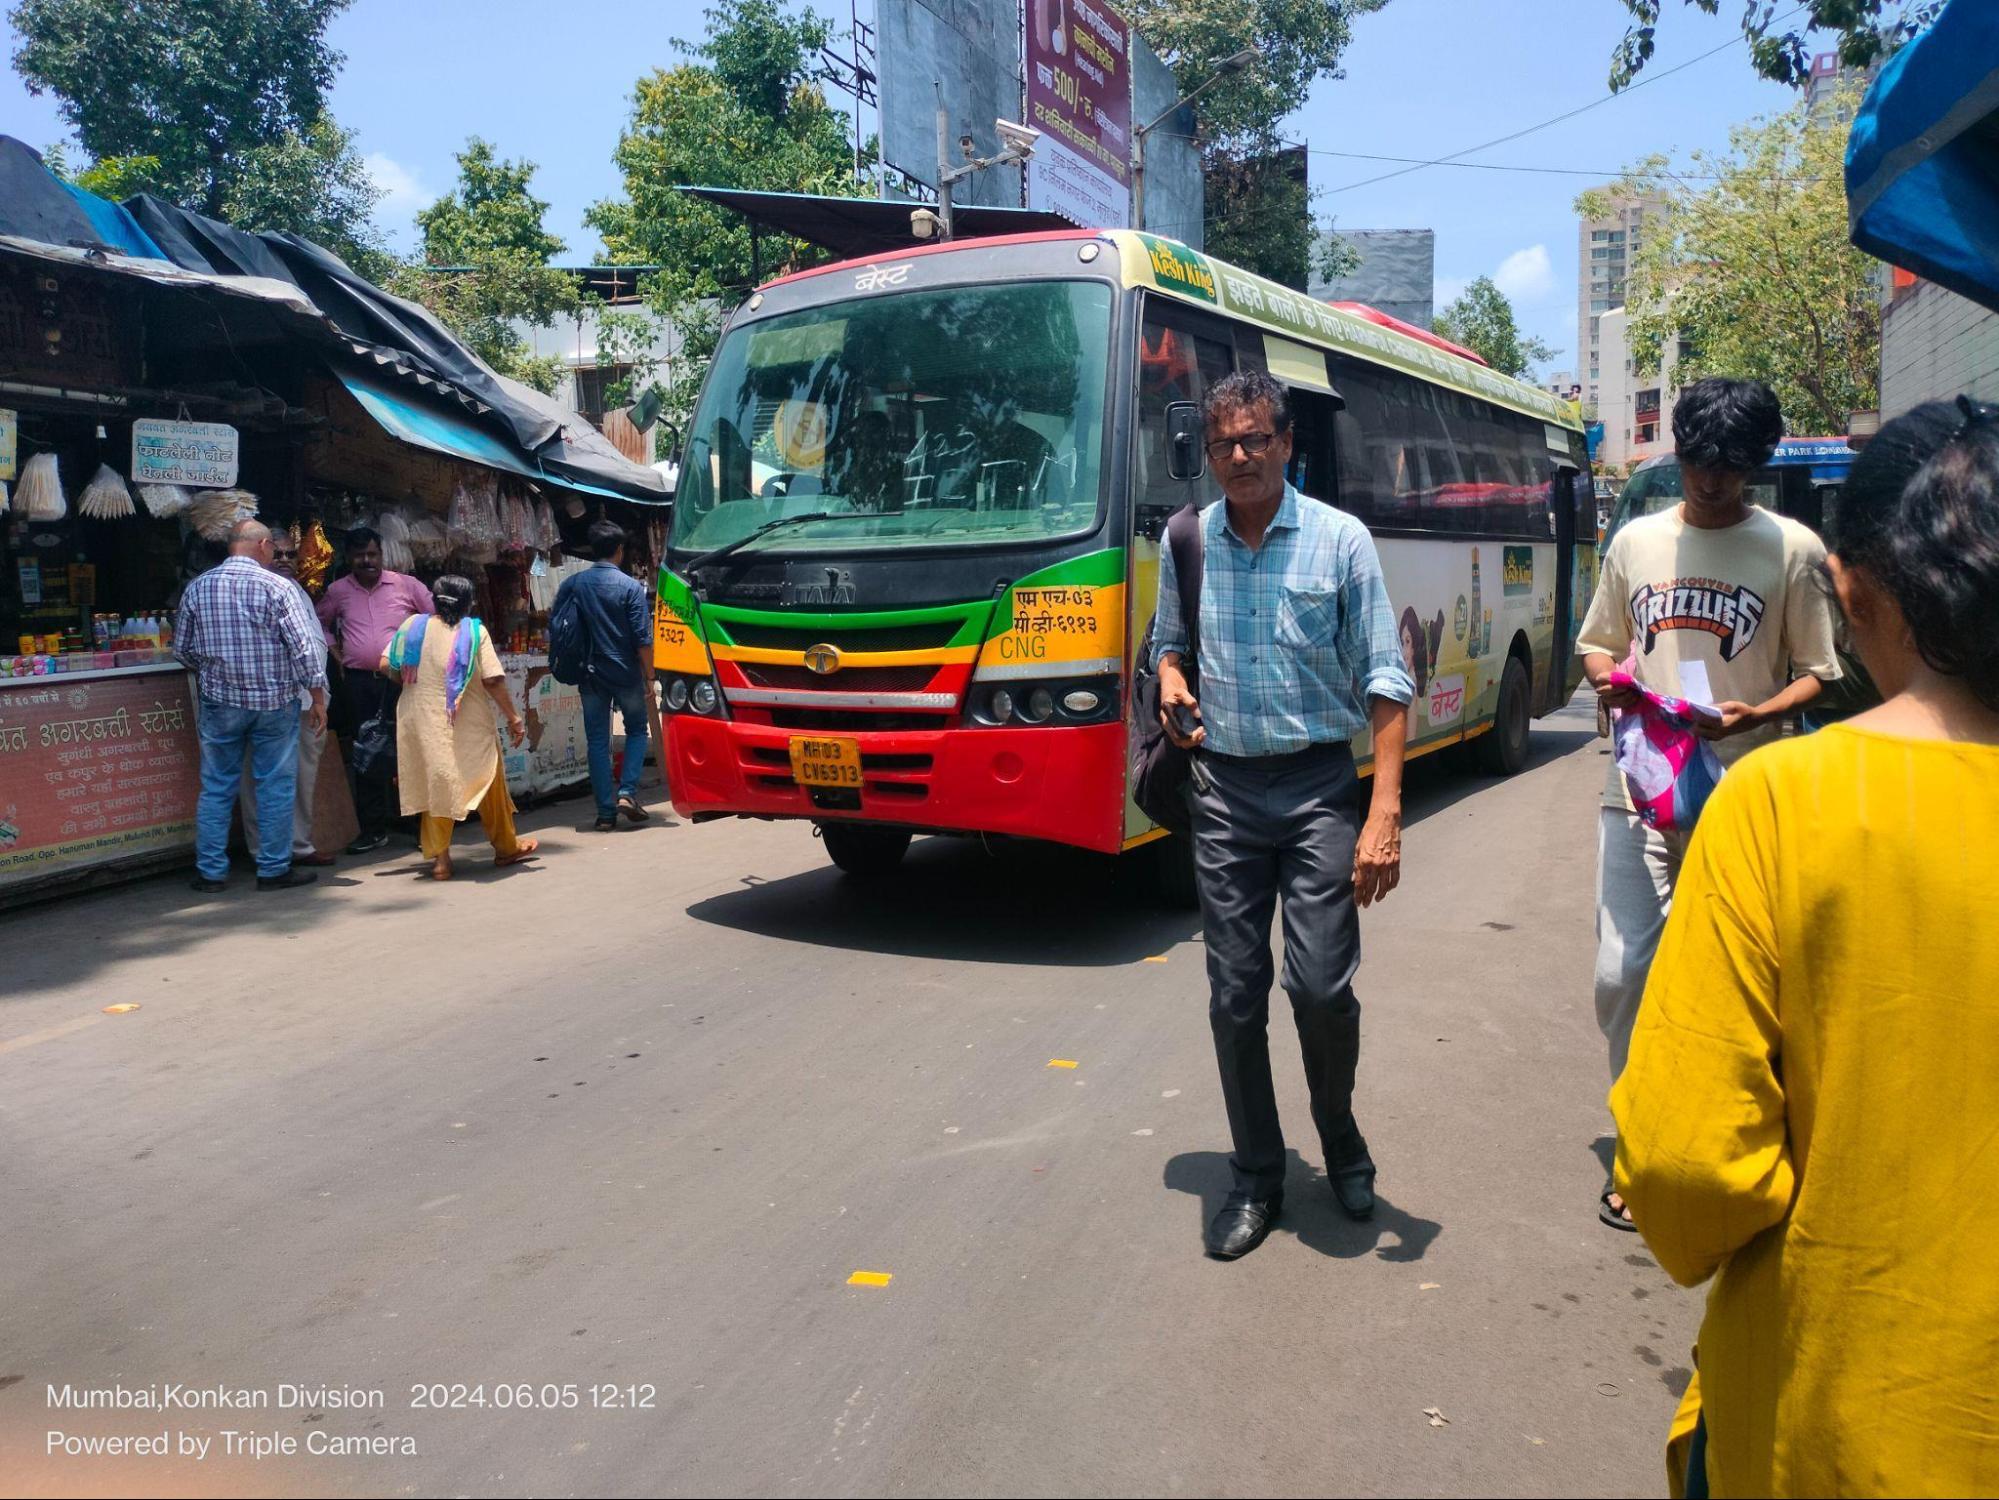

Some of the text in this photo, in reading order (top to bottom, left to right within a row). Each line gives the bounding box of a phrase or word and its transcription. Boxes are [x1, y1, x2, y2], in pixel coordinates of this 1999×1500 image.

[1054, 66, 1084, 113] 500/-
[856, 264, 913, 290] बेस्ट
[1150, 250, 1215, 297] Kesh King
[1299, 298, 1316, 329] के
[1313, 303, 1344, 342] लिए
[203, 446, 233, 462] नोट
[1789, 447, 1814, 456] PARK
[1653, 577, 1734, 593] VANCOUVER
[1016, 591, 1039, 608] एम
[1631, 585, 1764, 662] GRIZZLIES
[1000, 635, 1046, 659] CNG
[1431, 682, 1463, 718] बेस्ट
[40, 706, 132, 747] अगरबत्ती
[138, 699, 185, 734] स्टोर्स
[57, 747, 93, 766] सुगंधी
[101, 761, 114, 774] के
[803, 762, 859, 782] CV6913
